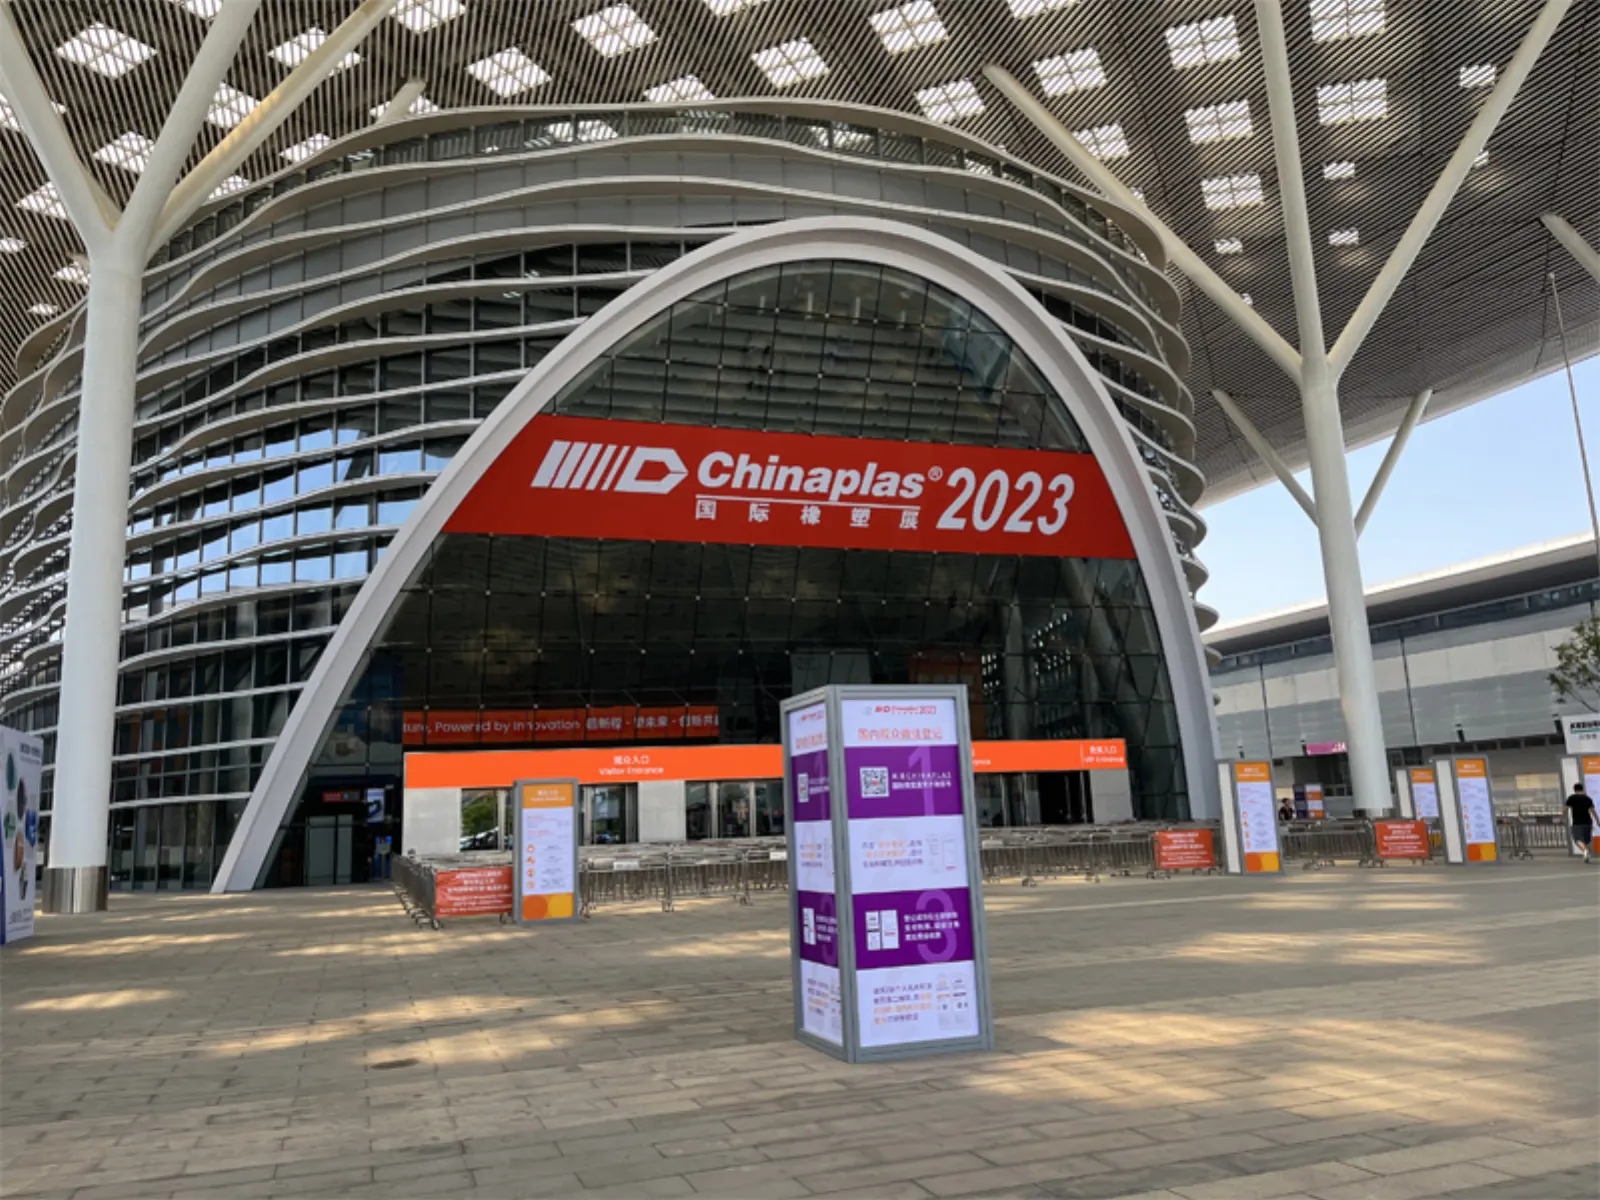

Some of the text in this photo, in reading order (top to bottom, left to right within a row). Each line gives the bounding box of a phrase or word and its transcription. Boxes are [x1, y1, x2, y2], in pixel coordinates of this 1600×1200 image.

[695, 500, 919, 529] 国际橡塑展
[936, 467, 1075, 535] 2023
[435, 721, 491, 733] Powered
[493, 721, 510, 734] by
